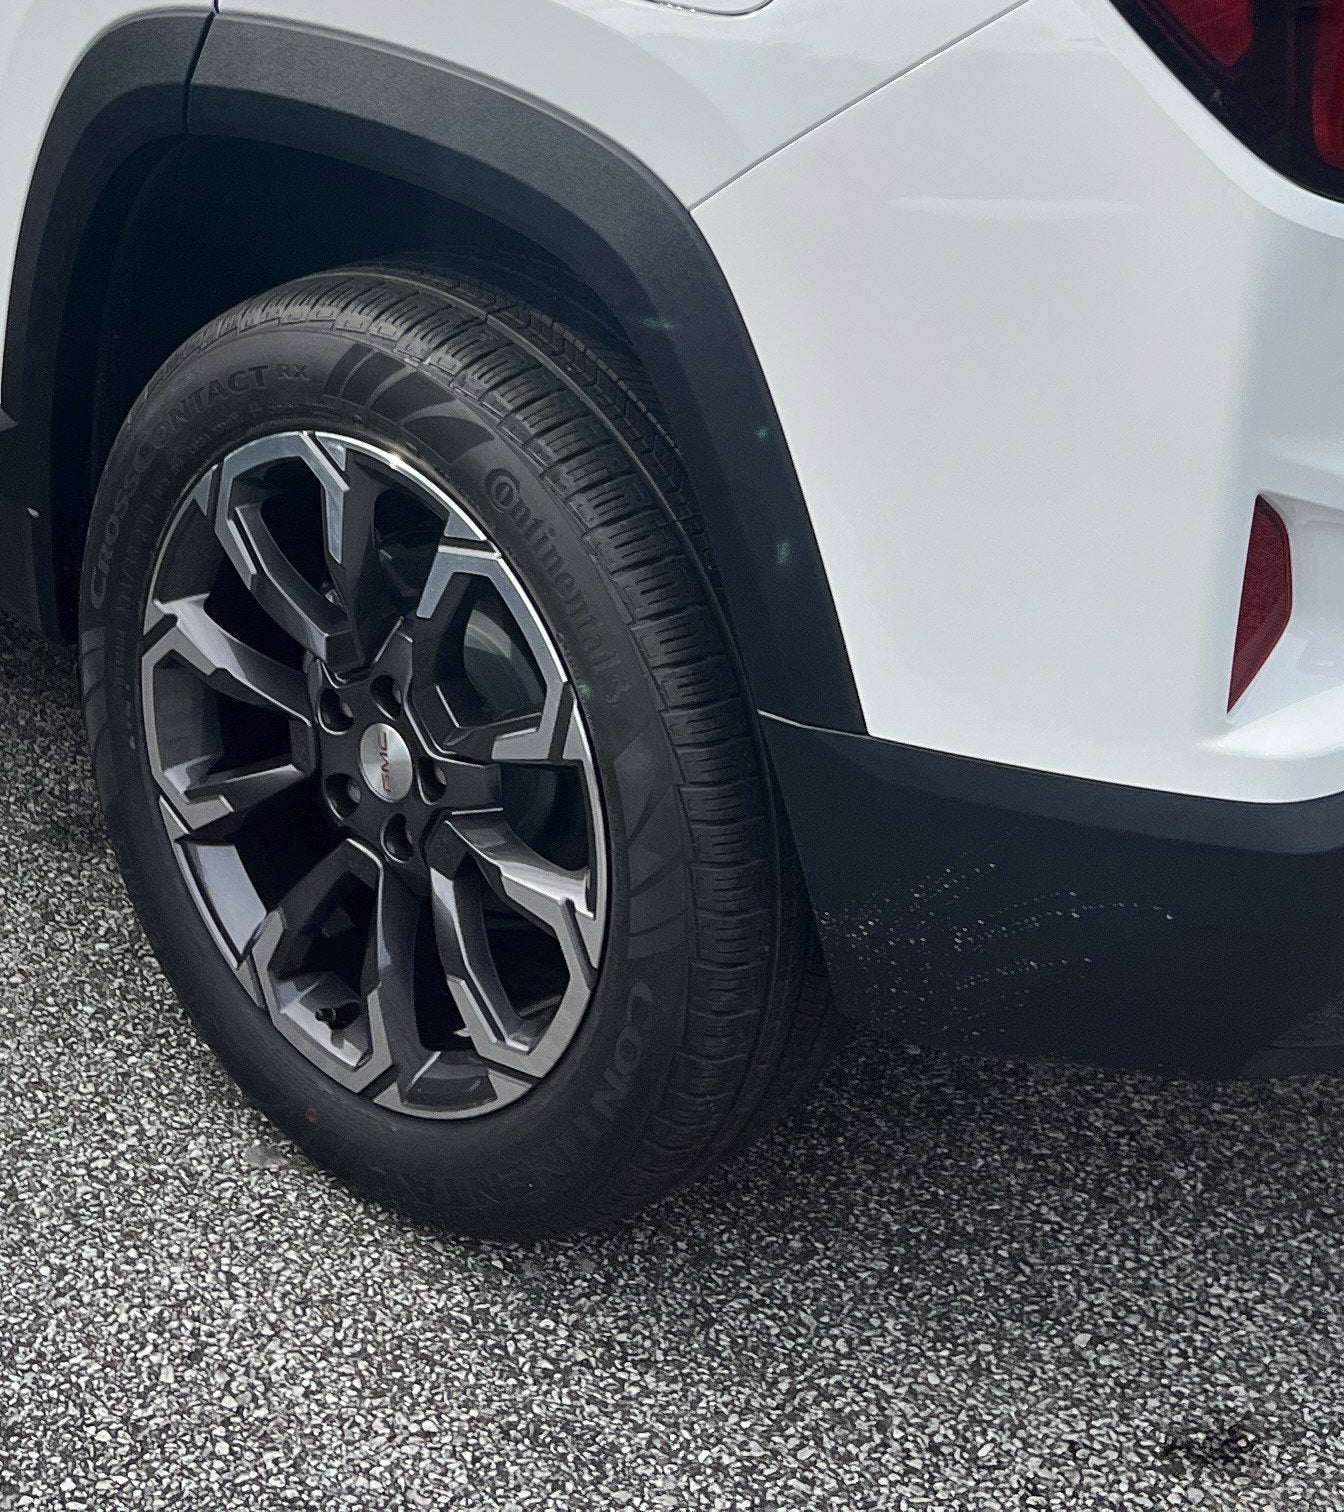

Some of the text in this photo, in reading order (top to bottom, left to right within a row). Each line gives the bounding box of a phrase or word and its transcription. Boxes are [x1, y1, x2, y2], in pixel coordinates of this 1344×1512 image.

[276, 363, 309, 381] RX
[485, 468, 623, 673] Continental
[378, 730, 391, 792] GMC
